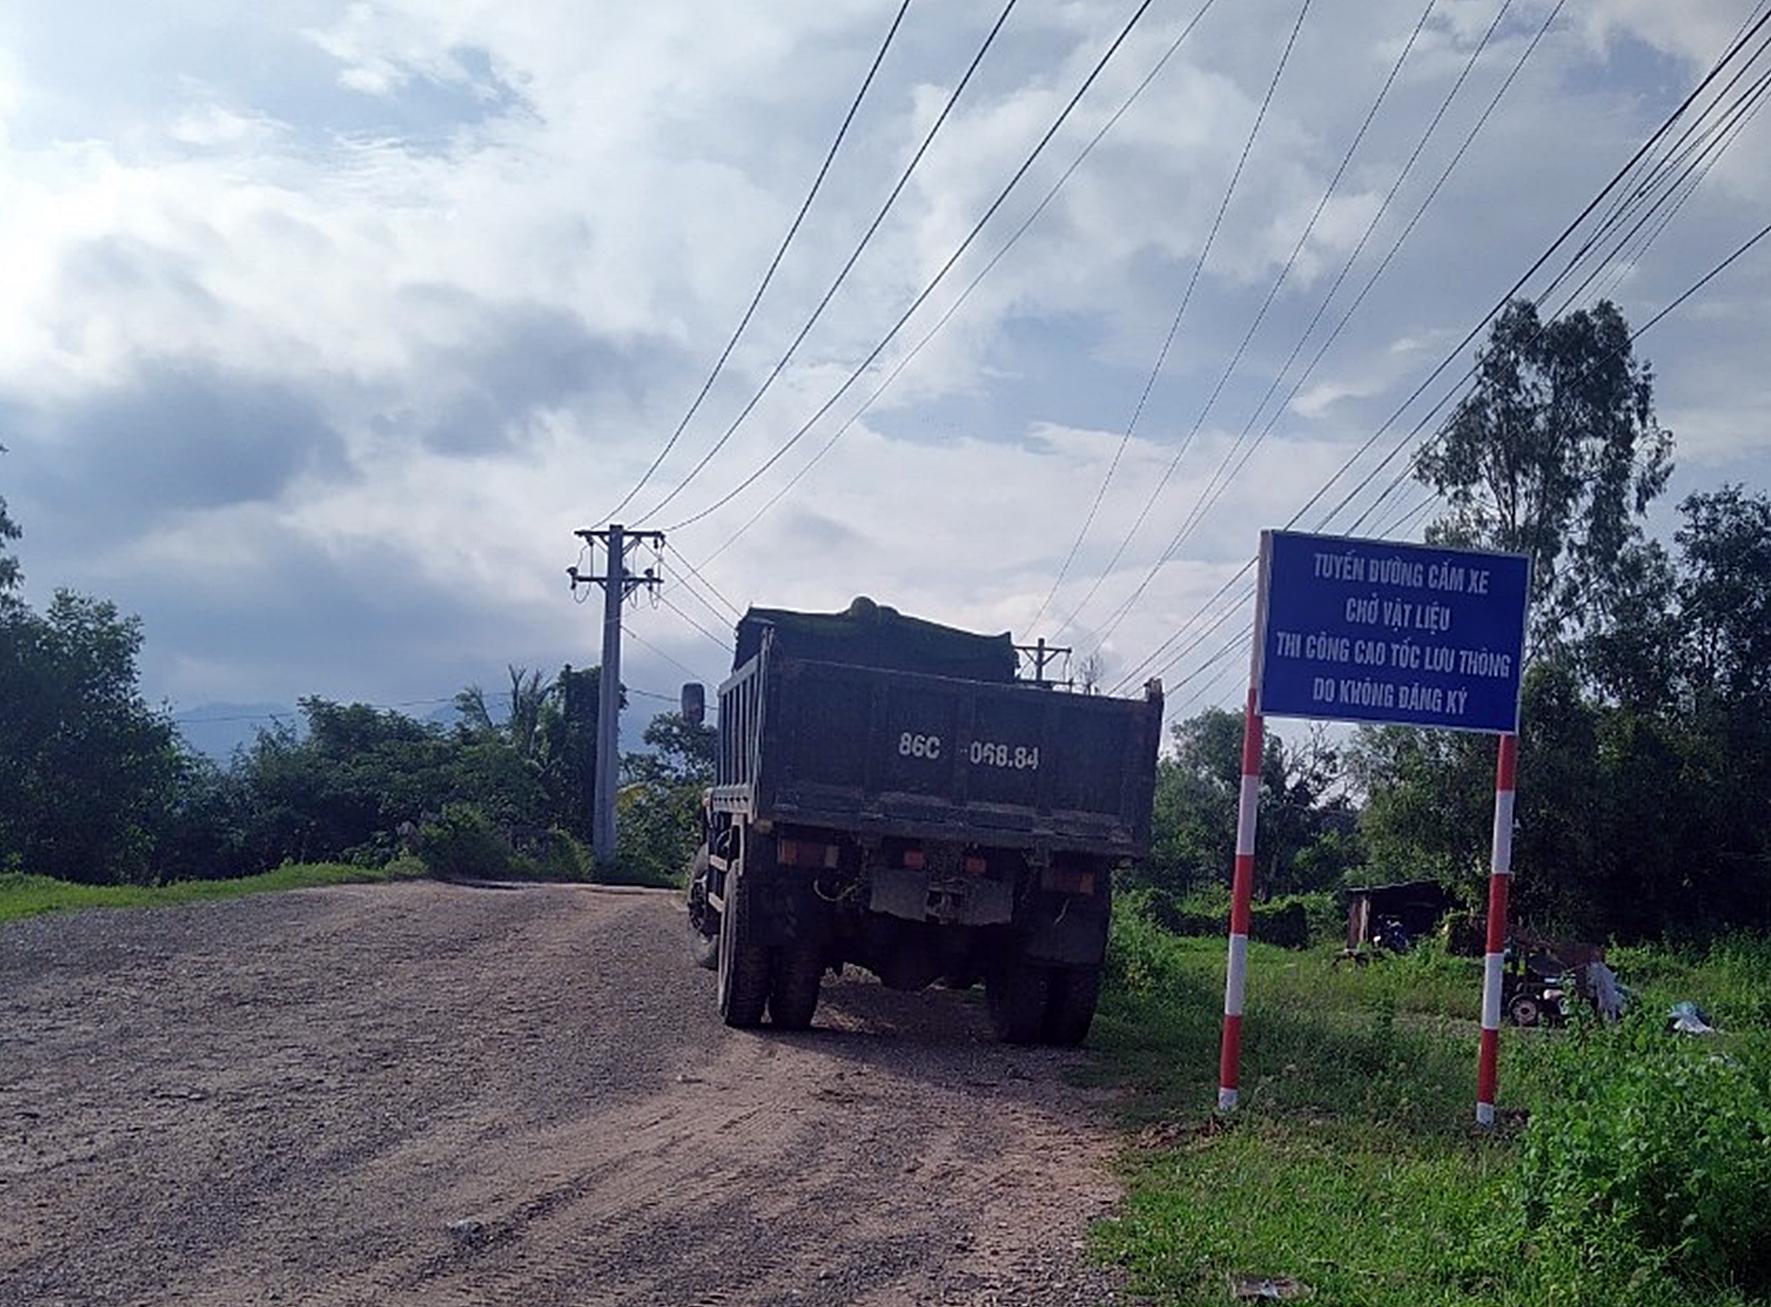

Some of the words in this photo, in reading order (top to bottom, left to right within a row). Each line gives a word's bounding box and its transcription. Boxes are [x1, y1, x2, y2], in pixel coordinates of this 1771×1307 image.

[1314, 549, 1365, 580] TUYẾN
[1368, 556, 1424, 588] ĐƯỜNG
[1467, 568, 1490, 594] XE
[1345, 592, 1379, 625] CHỞ
[1383, 598, 1412, 632] VẬT
[1416, 601, 1451, 635] LIỆU
[1277, 632, 1302, 658] THI
[1306, 632, 1350, 662] CÔNG
[1354, 640, 1386, 665] CAO
[1390, 636, 1421, 669] TỐC
[1424, 646, 1456, 673] LƯU
[1459, 648, 1511, 678] THÔNG
[1313, 677, 1335, 702] DO
[1339, 677, 1395, 708] KHÔNG
[1445, 686, 1468, 715] KÝ
[898, 732, 940, 759] 86C
